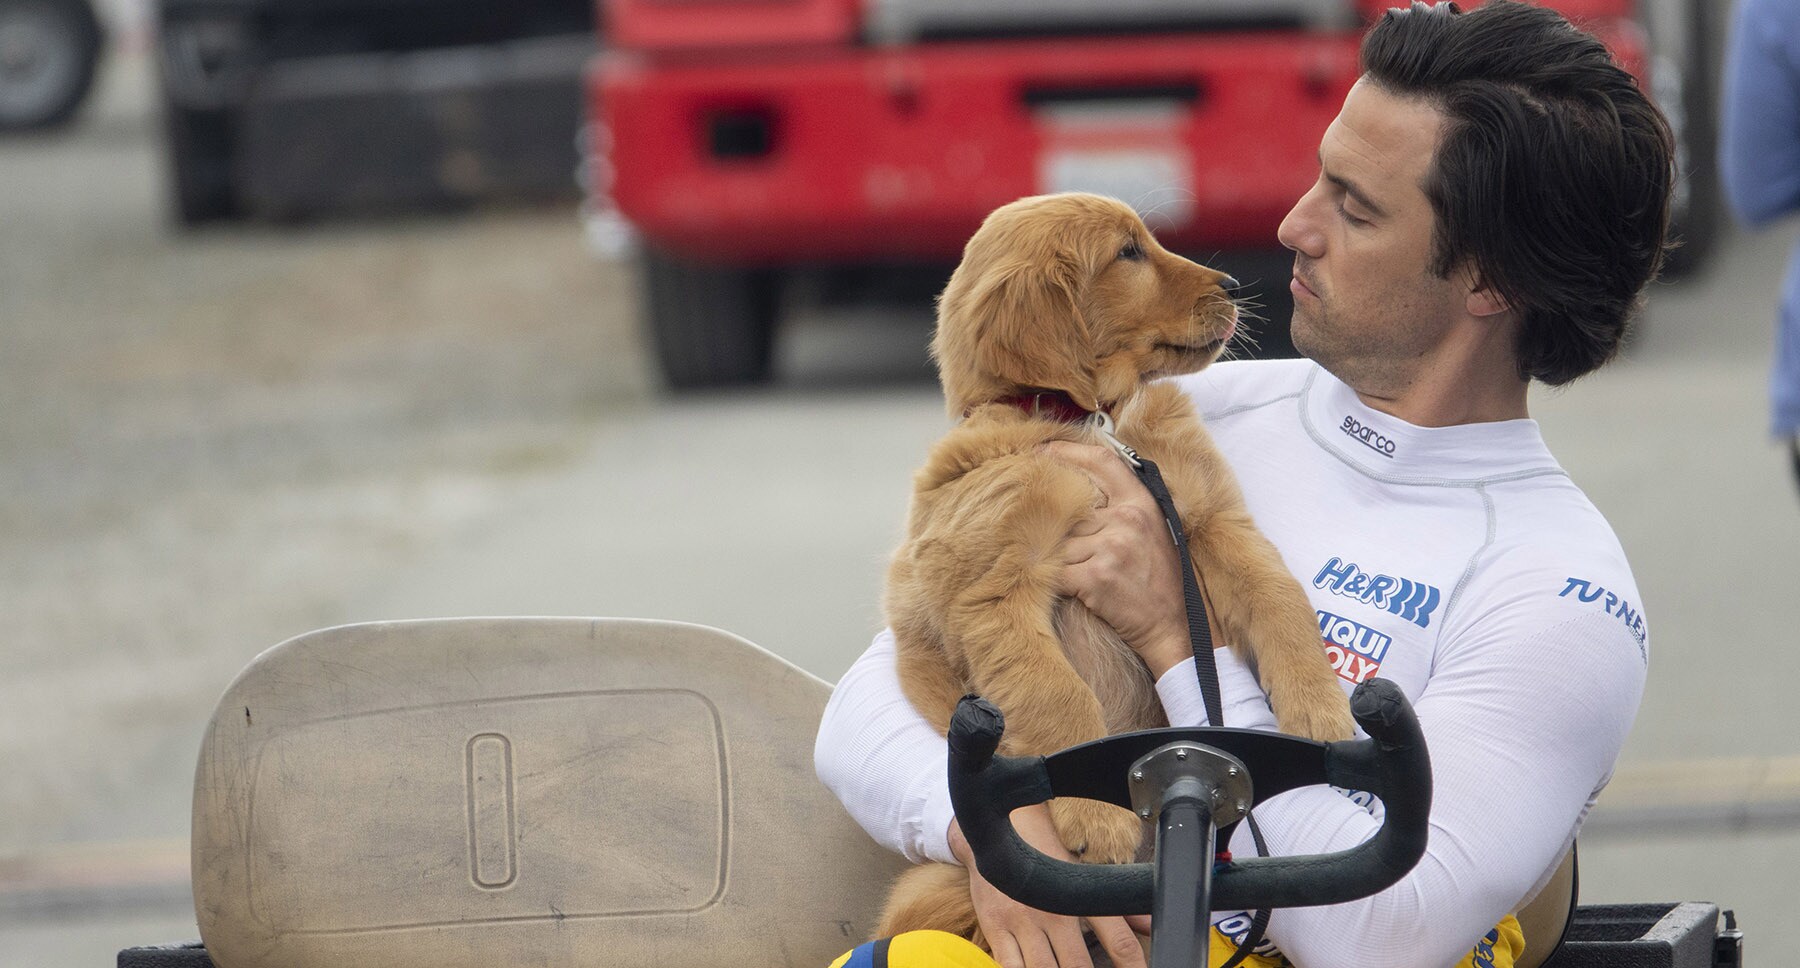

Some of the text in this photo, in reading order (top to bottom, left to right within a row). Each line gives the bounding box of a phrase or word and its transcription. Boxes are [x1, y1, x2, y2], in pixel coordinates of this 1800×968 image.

[1340, 415, 1396, 457] sparco
[1313, 557, 1398, 609] H&R
[1322, 643, 1378, 683] OLY
